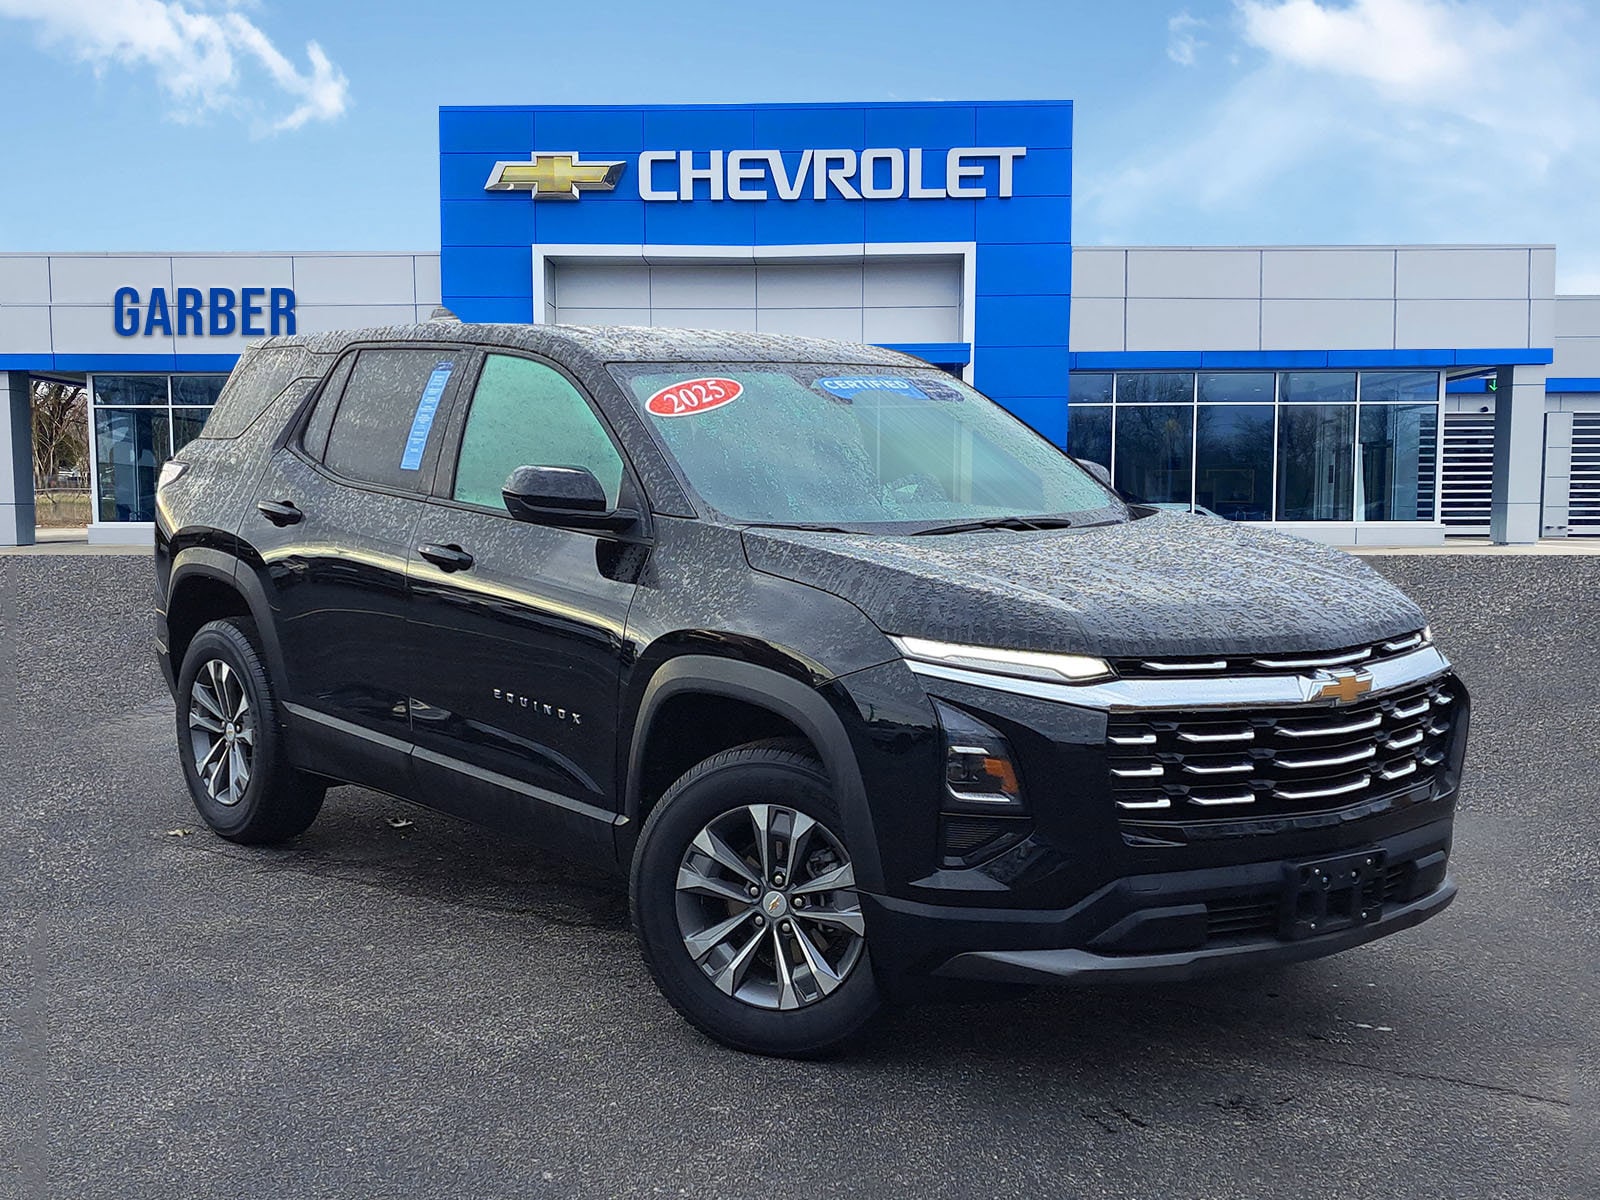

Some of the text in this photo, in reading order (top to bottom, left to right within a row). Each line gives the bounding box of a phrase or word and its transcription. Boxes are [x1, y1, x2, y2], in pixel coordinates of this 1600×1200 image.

[638, 146, 1027, 201] CHEVROLET
[114, 286, 297, 337] GARBER
[663, 380, 725, 413] 2025
[823, 379, 910, 390] CERTIFIED
[493, 688, 582, 725] EQUINOX
